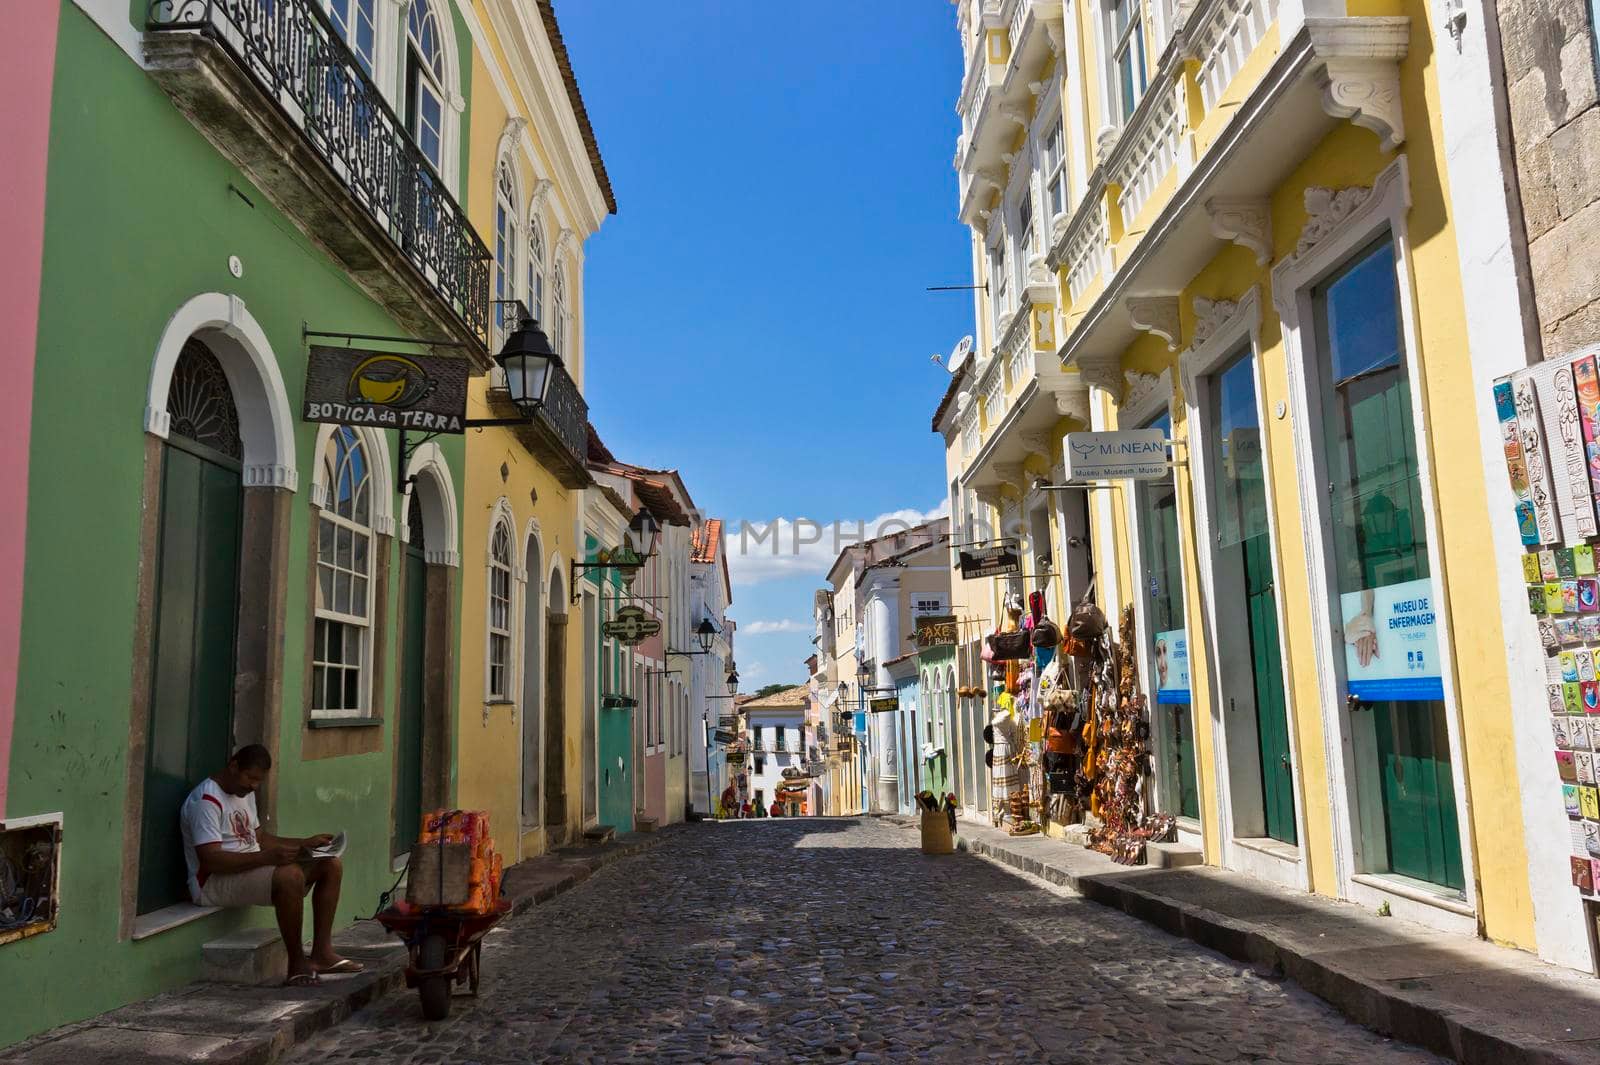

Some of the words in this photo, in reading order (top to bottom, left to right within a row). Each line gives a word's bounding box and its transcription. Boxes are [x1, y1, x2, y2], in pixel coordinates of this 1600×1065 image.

[307, 402, 377, 423] BOTICA
[379, 411, 396, 423] da
[401, 411, 461, 430] TERRA
[1393, 600, 1417, 614] MUSEU
[1417, 598, 1428, 610] DE
